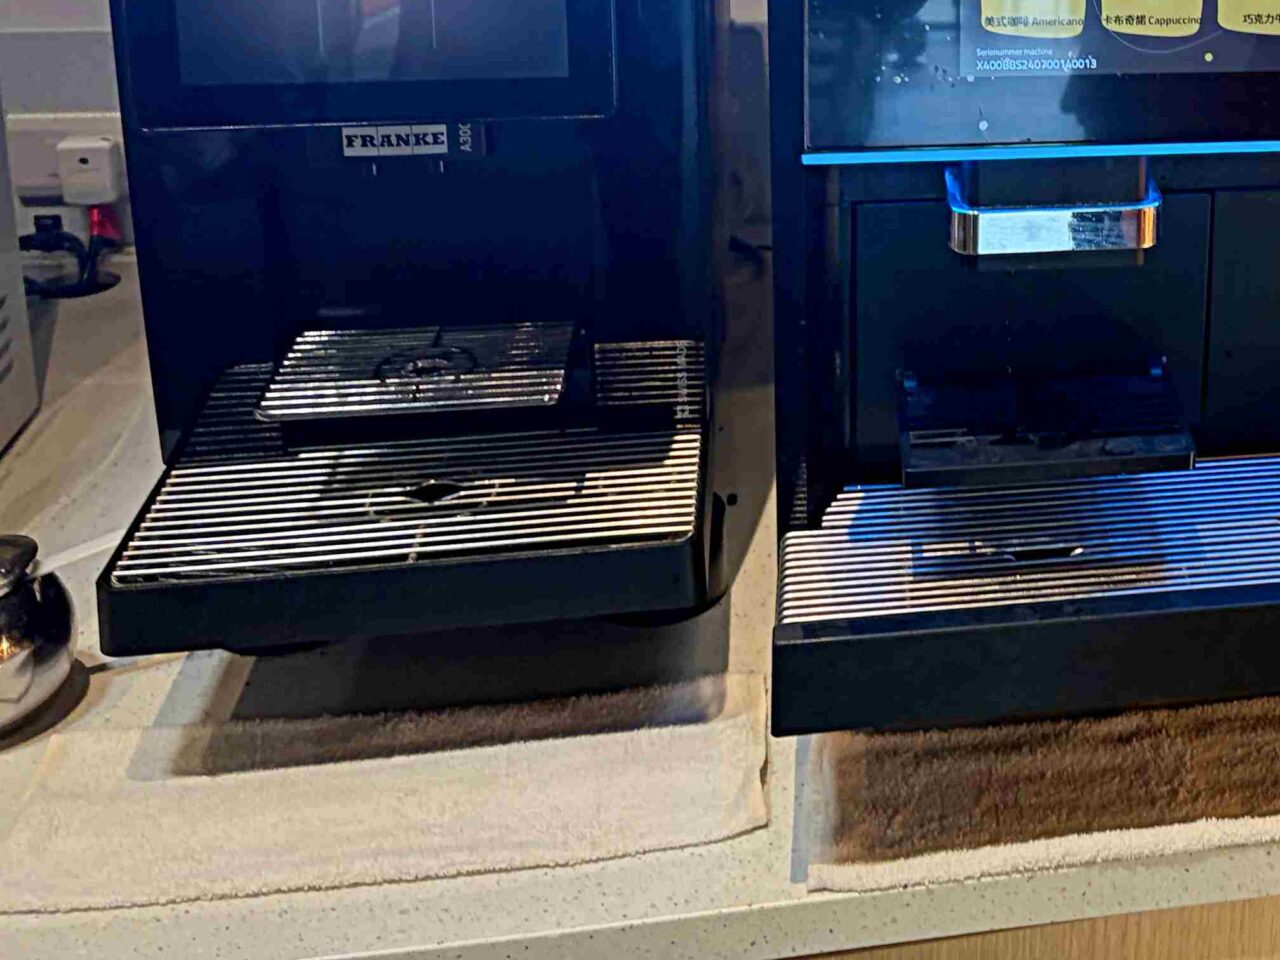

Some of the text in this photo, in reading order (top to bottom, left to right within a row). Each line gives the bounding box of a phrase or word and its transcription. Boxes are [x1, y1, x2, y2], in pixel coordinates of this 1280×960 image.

[1031, 16, 1084, 27] Americano
[1148, 16, 1203, 28] Cappuccino
[344, 132, 445, 148] FRANKE
